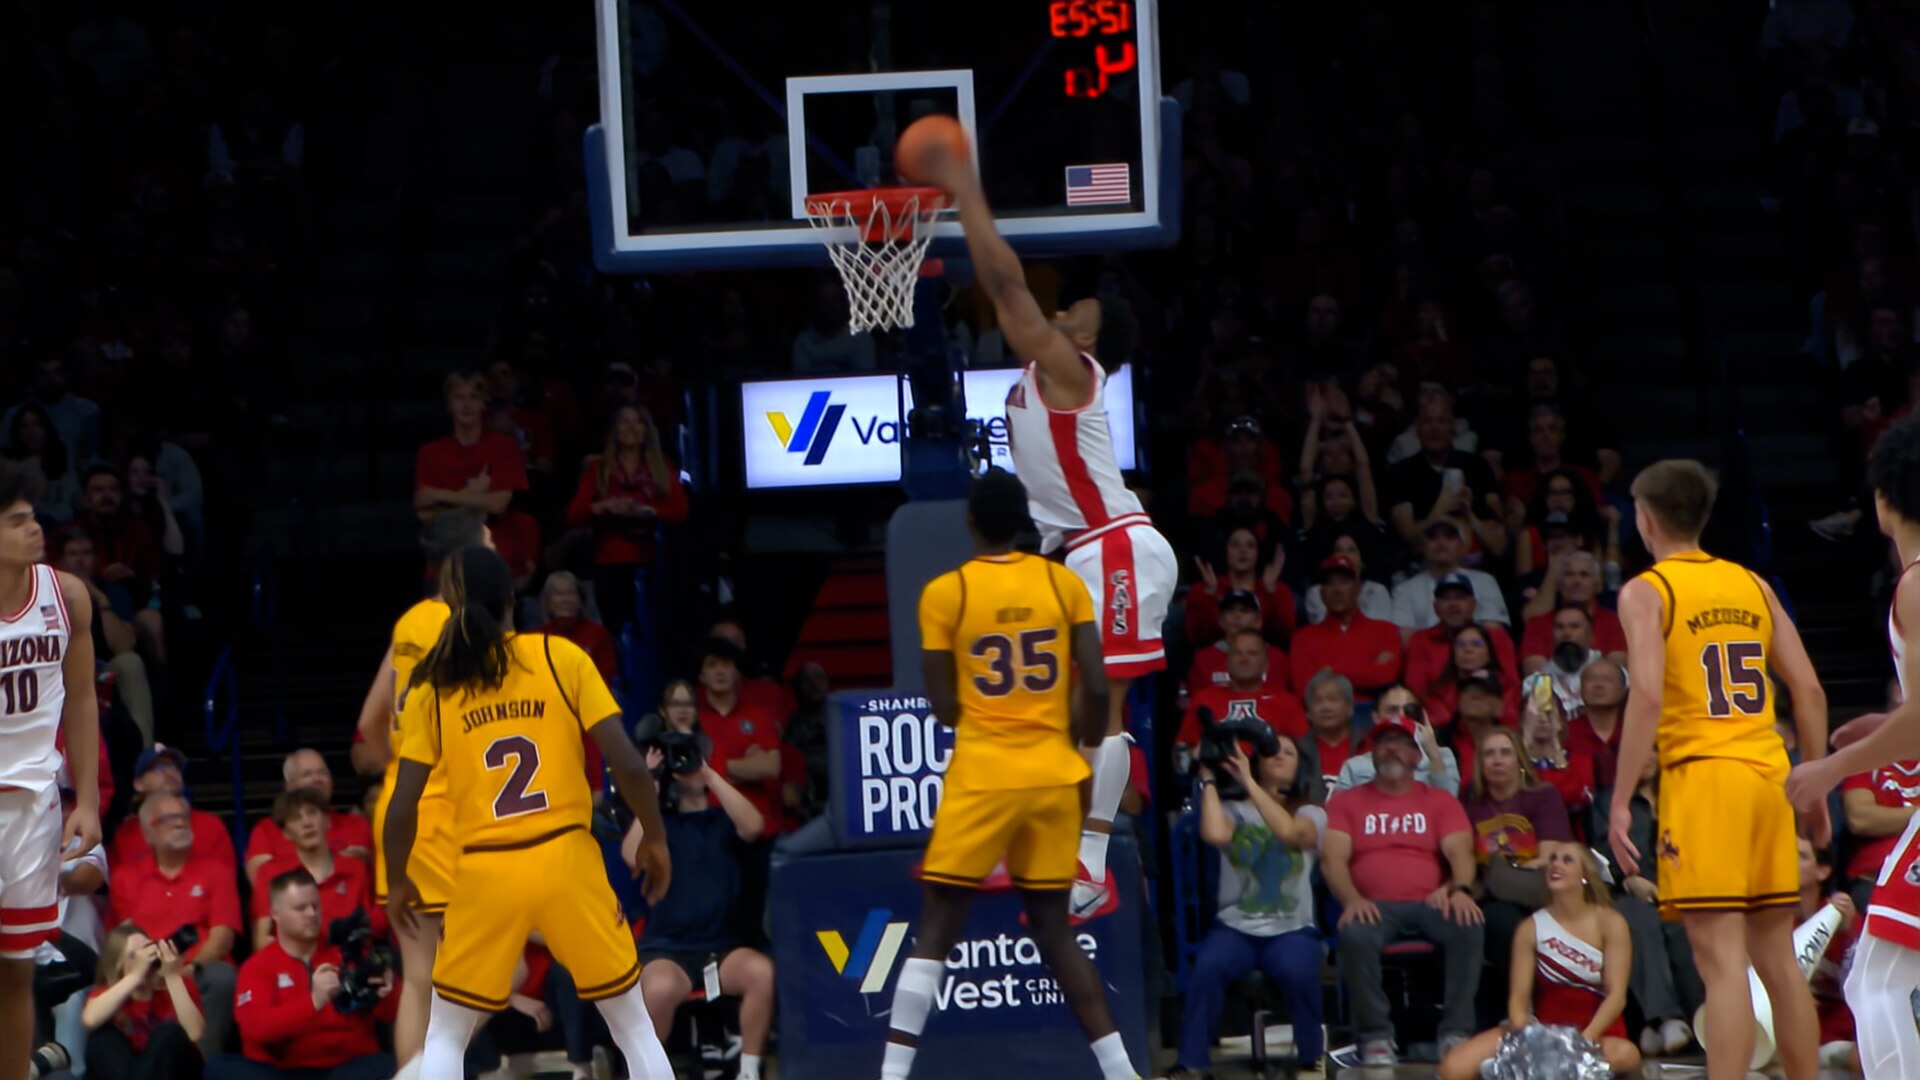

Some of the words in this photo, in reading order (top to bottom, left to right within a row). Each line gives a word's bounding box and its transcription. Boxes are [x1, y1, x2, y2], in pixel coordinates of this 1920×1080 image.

[1111, 569, 1131, 635] CATS
[1686, 607, 1762, 635] MEEUSEN
[969, 627, 1060, 699] 35
[1700, 640, 1768, 718] 15
[0, 668, 39, 716] 10
[461, 699, 546, 734] JOHNSON
[483, 734, 550, 821] 2
[912, 933, 1098, 970] antae
